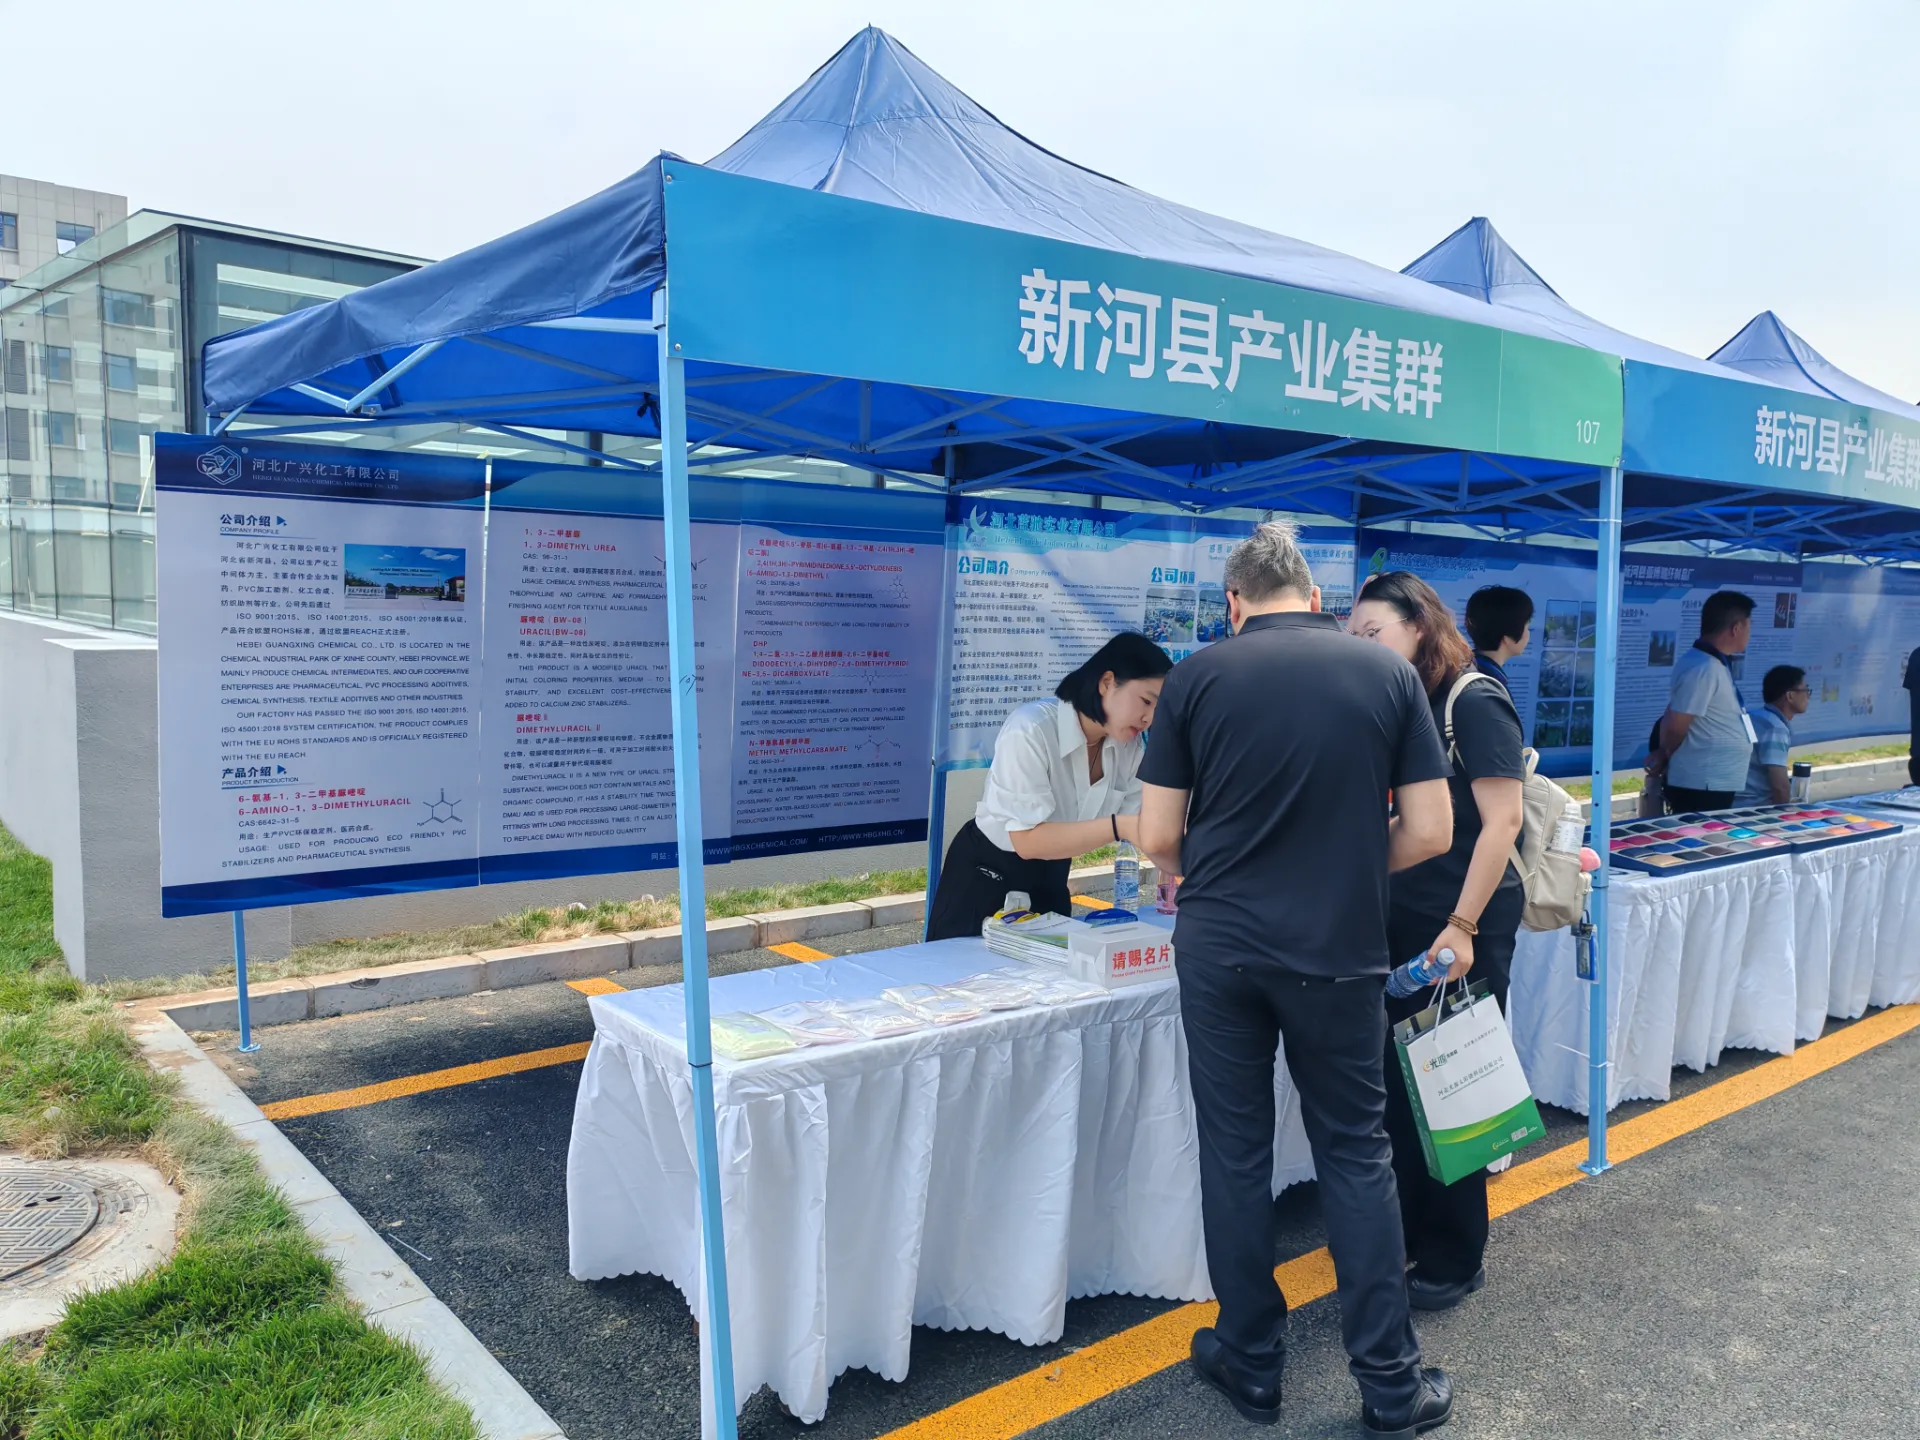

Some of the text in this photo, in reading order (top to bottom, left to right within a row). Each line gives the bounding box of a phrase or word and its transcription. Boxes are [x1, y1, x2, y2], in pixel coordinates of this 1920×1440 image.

[1019, 268, 1443, 418] 新河县产业集群
[1576, 419, 1600, 444] 107
[1754, 405, 1920, 491] 新河县产业集群
[252, 458, 399, 481] 河北广兴化工有限公司
[220, 514, 271, 526] 公司介绍
[594, 543, 616, 552] UREA
[958, 555, 1009, 575] 公司简介
[1010, 568, 1039, 576] Company
[1151, 566, 1195, 584] 公司环境
[222, 766, 272, 778] 产品介绍
[253, 776, 298, 785] INTRODUCTION
[278, 841, 300, 849] USED
[309, 839, 325, 847] FOR
[333, 835, 379, 845] PRODUCING
[410, 831, 445, 840] FRIENDLY
[452, 829, 467, 837] PVC
[222, 856, 274, 867] STABILIZERS
[296, 849, 367, 861] PHARMACEUTICAL
[1112, 944, 1171, 970] 请赐名片
